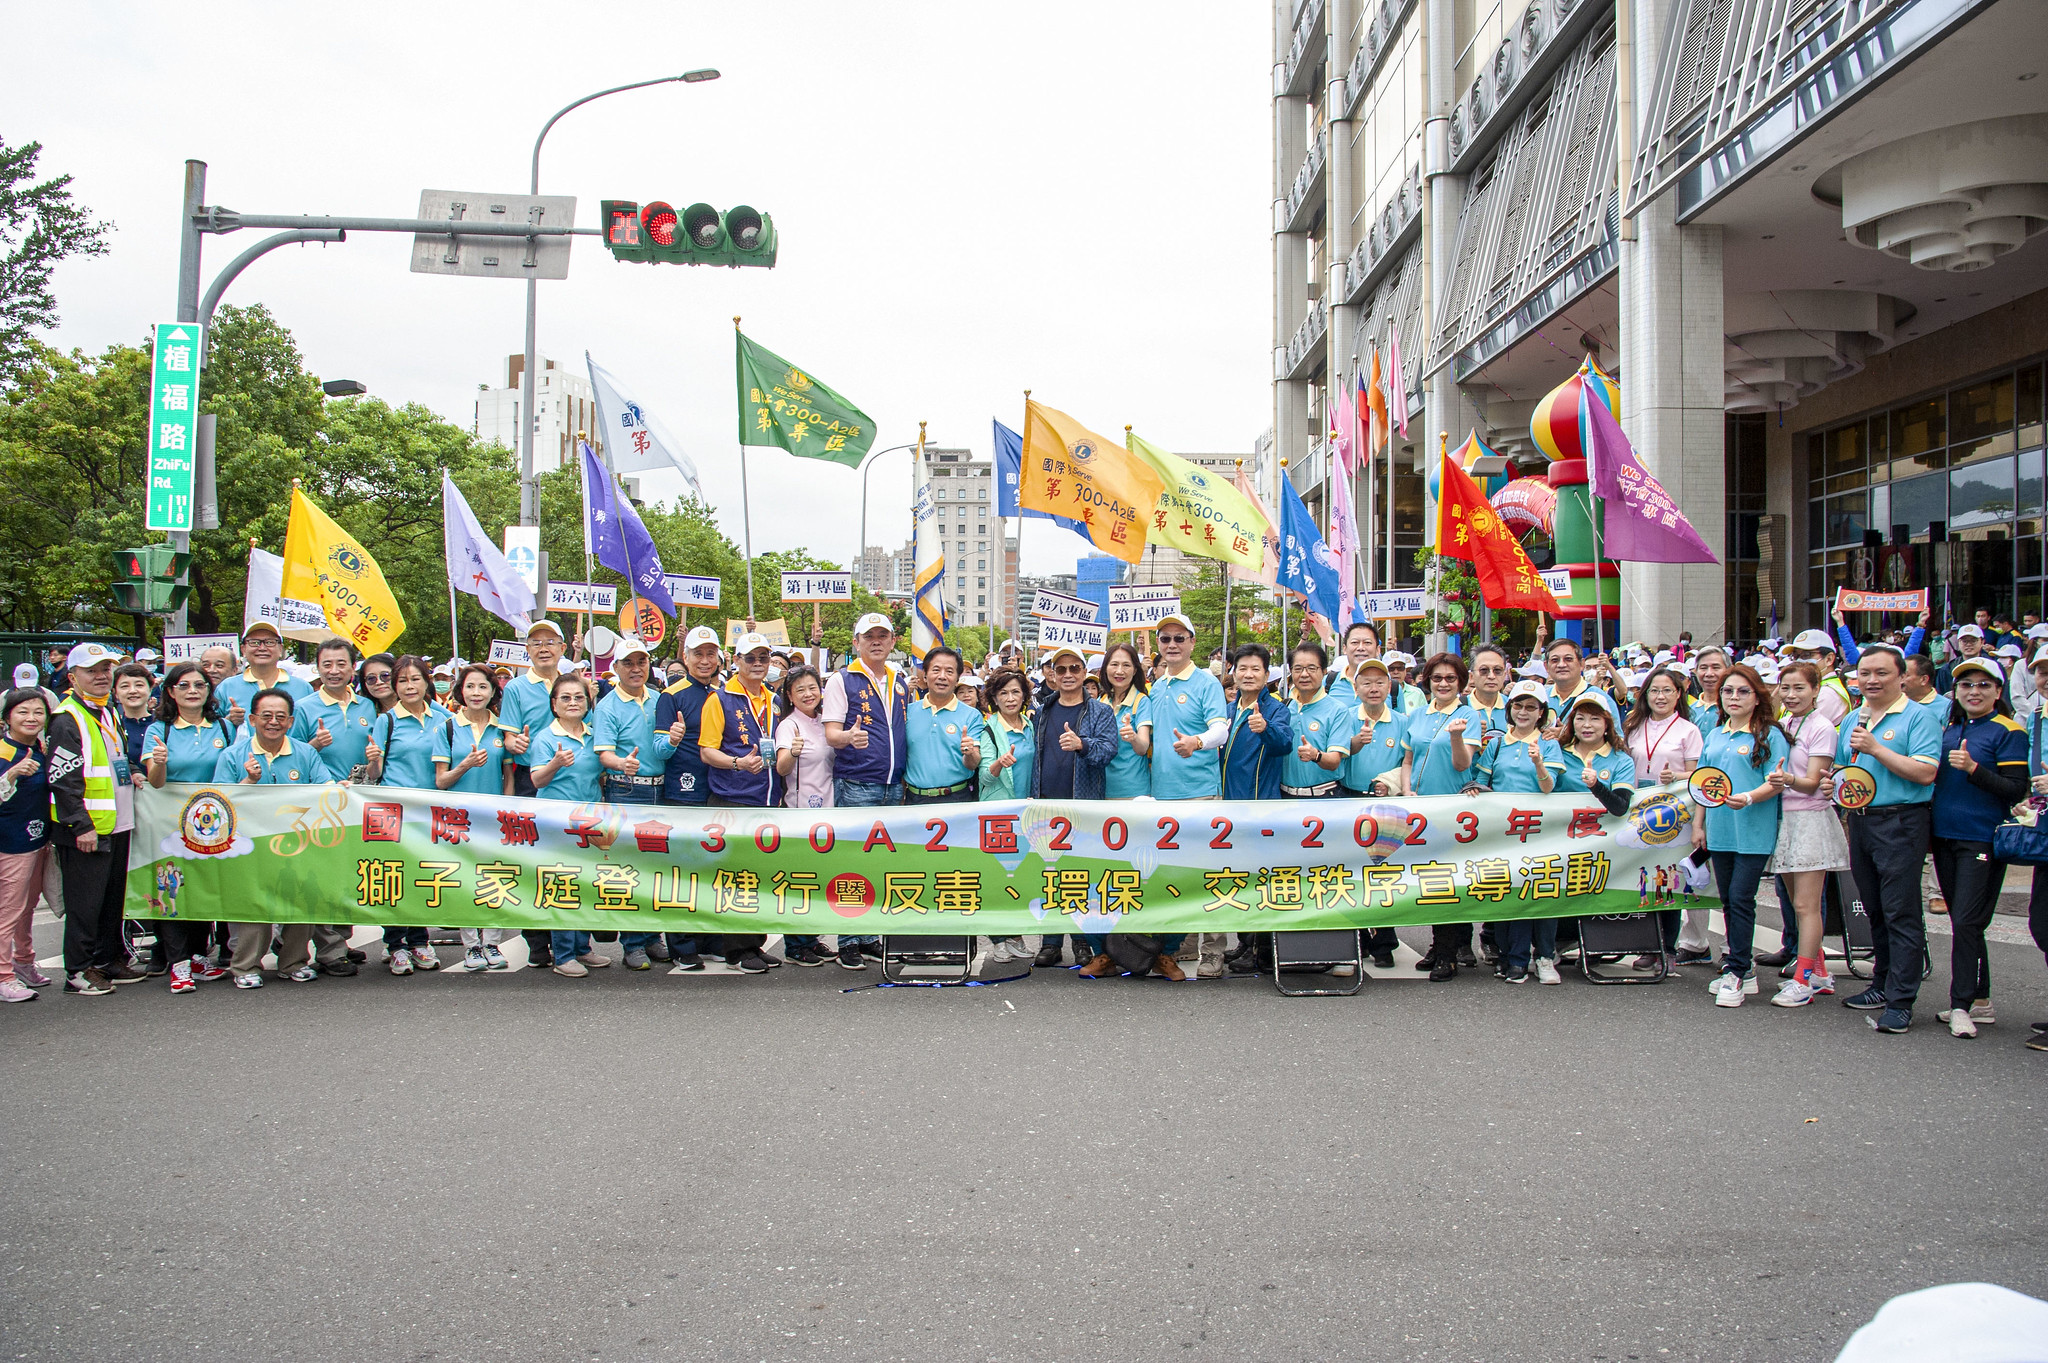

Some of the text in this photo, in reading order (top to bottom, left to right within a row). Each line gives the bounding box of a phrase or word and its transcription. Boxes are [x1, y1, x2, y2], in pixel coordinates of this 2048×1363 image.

[159, 344, 191, 450] 植福路
[756, 408, 847, 451] 第專區
[631, 430, 651, 456] 第
[153, 458, 190, 472] ZhiFu
[1621, 464, 1641, 481] We
[153, 476, 173, 489] Rd.
[1154, 509, 1250, 556] 第七專區
[786, 579, 847, 594] 第十專區
[552, 588, 612, 606] 第六專區
[1364, 596, 1421, 612] 第二專區
[1038, 597, 1093, 622] 第八專區
[1044, 626, 1103, 646] 第九專區
[356, 851, 1611, 917] 獅子家庭登山健行暨反毒、環保、交通秩序宣導活動
